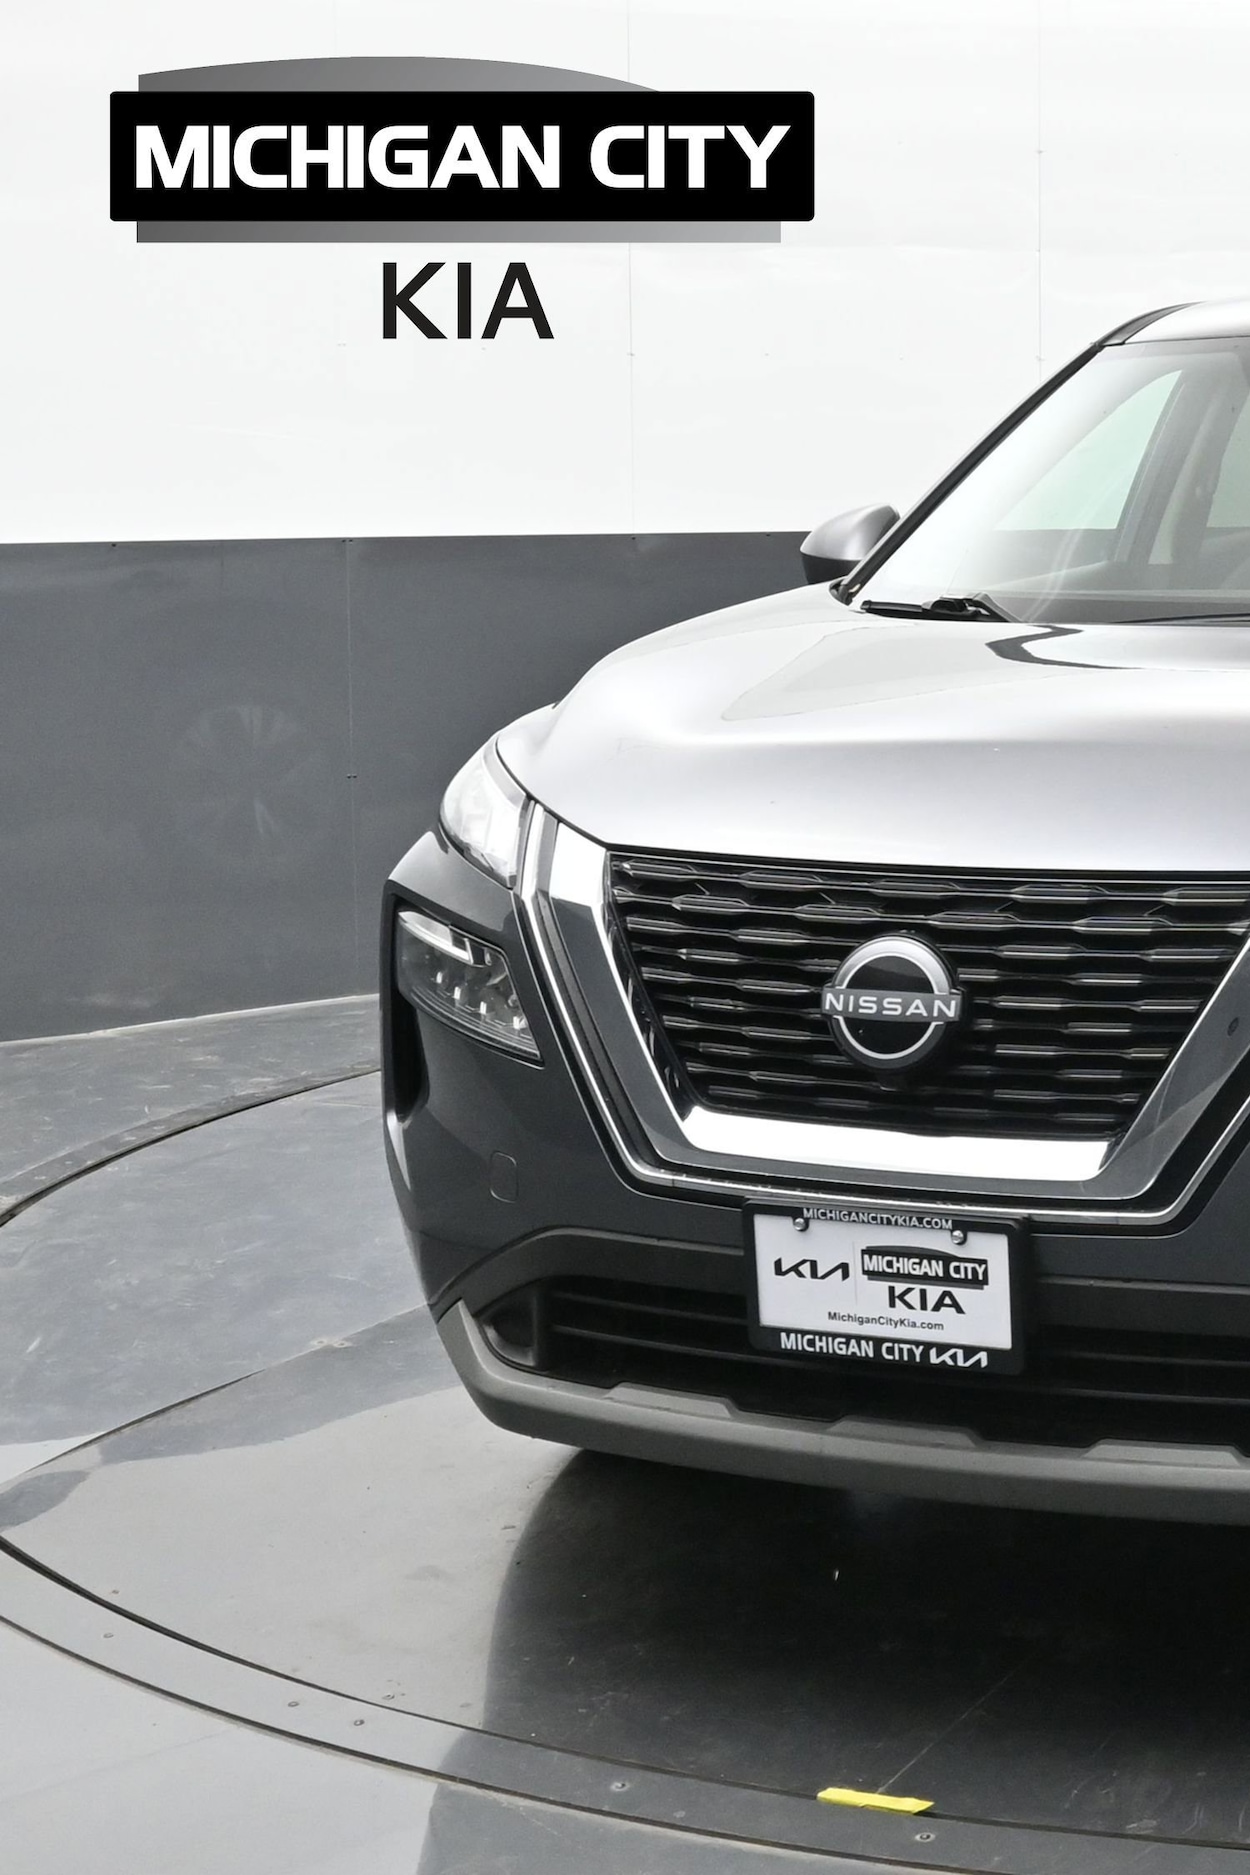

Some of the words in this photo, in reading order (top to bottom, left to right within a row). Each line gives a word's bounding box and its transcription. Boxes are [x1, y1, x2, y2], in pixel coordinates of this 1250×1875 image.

[825, 993, 956, 1018] NISSAN
[803, 1207, 953, 1230] MICHIGANCITYKIA.COM
[862, 1254, 943, 1277] MICHIGAN
[949, 1261, 987, 1281] CITY
[888, 1286, 966, 1314] KIA
[827, 1312, 945, 1331] MichiganCityKia.com
[780, 1332, 874, 1358] MICHIGAN
[881, 1342, 924, 1363] CITY
